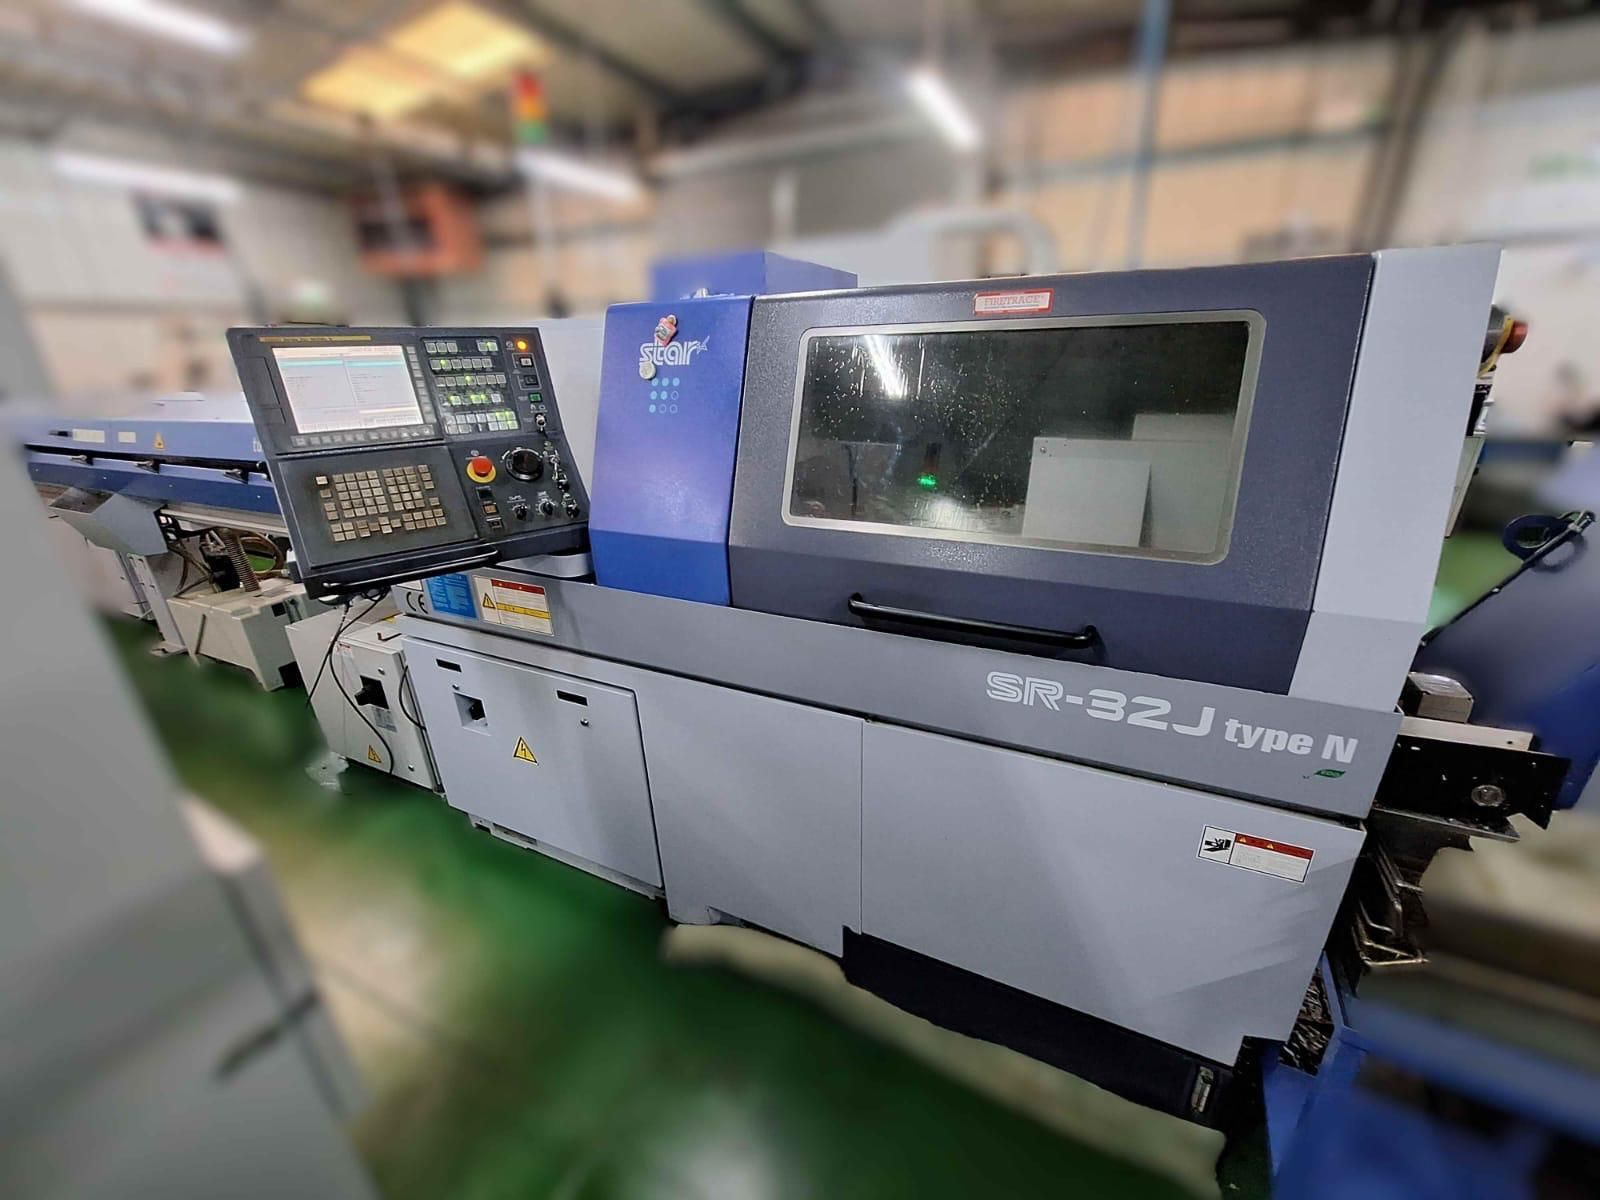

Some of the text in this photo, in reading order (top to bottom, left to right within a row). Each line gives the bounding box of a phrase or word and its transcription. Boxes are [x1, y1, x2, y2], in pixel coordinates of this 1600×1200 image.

[639, 340, 699, 366] star
[986, 671, 1359, 764] SR-32J type N
